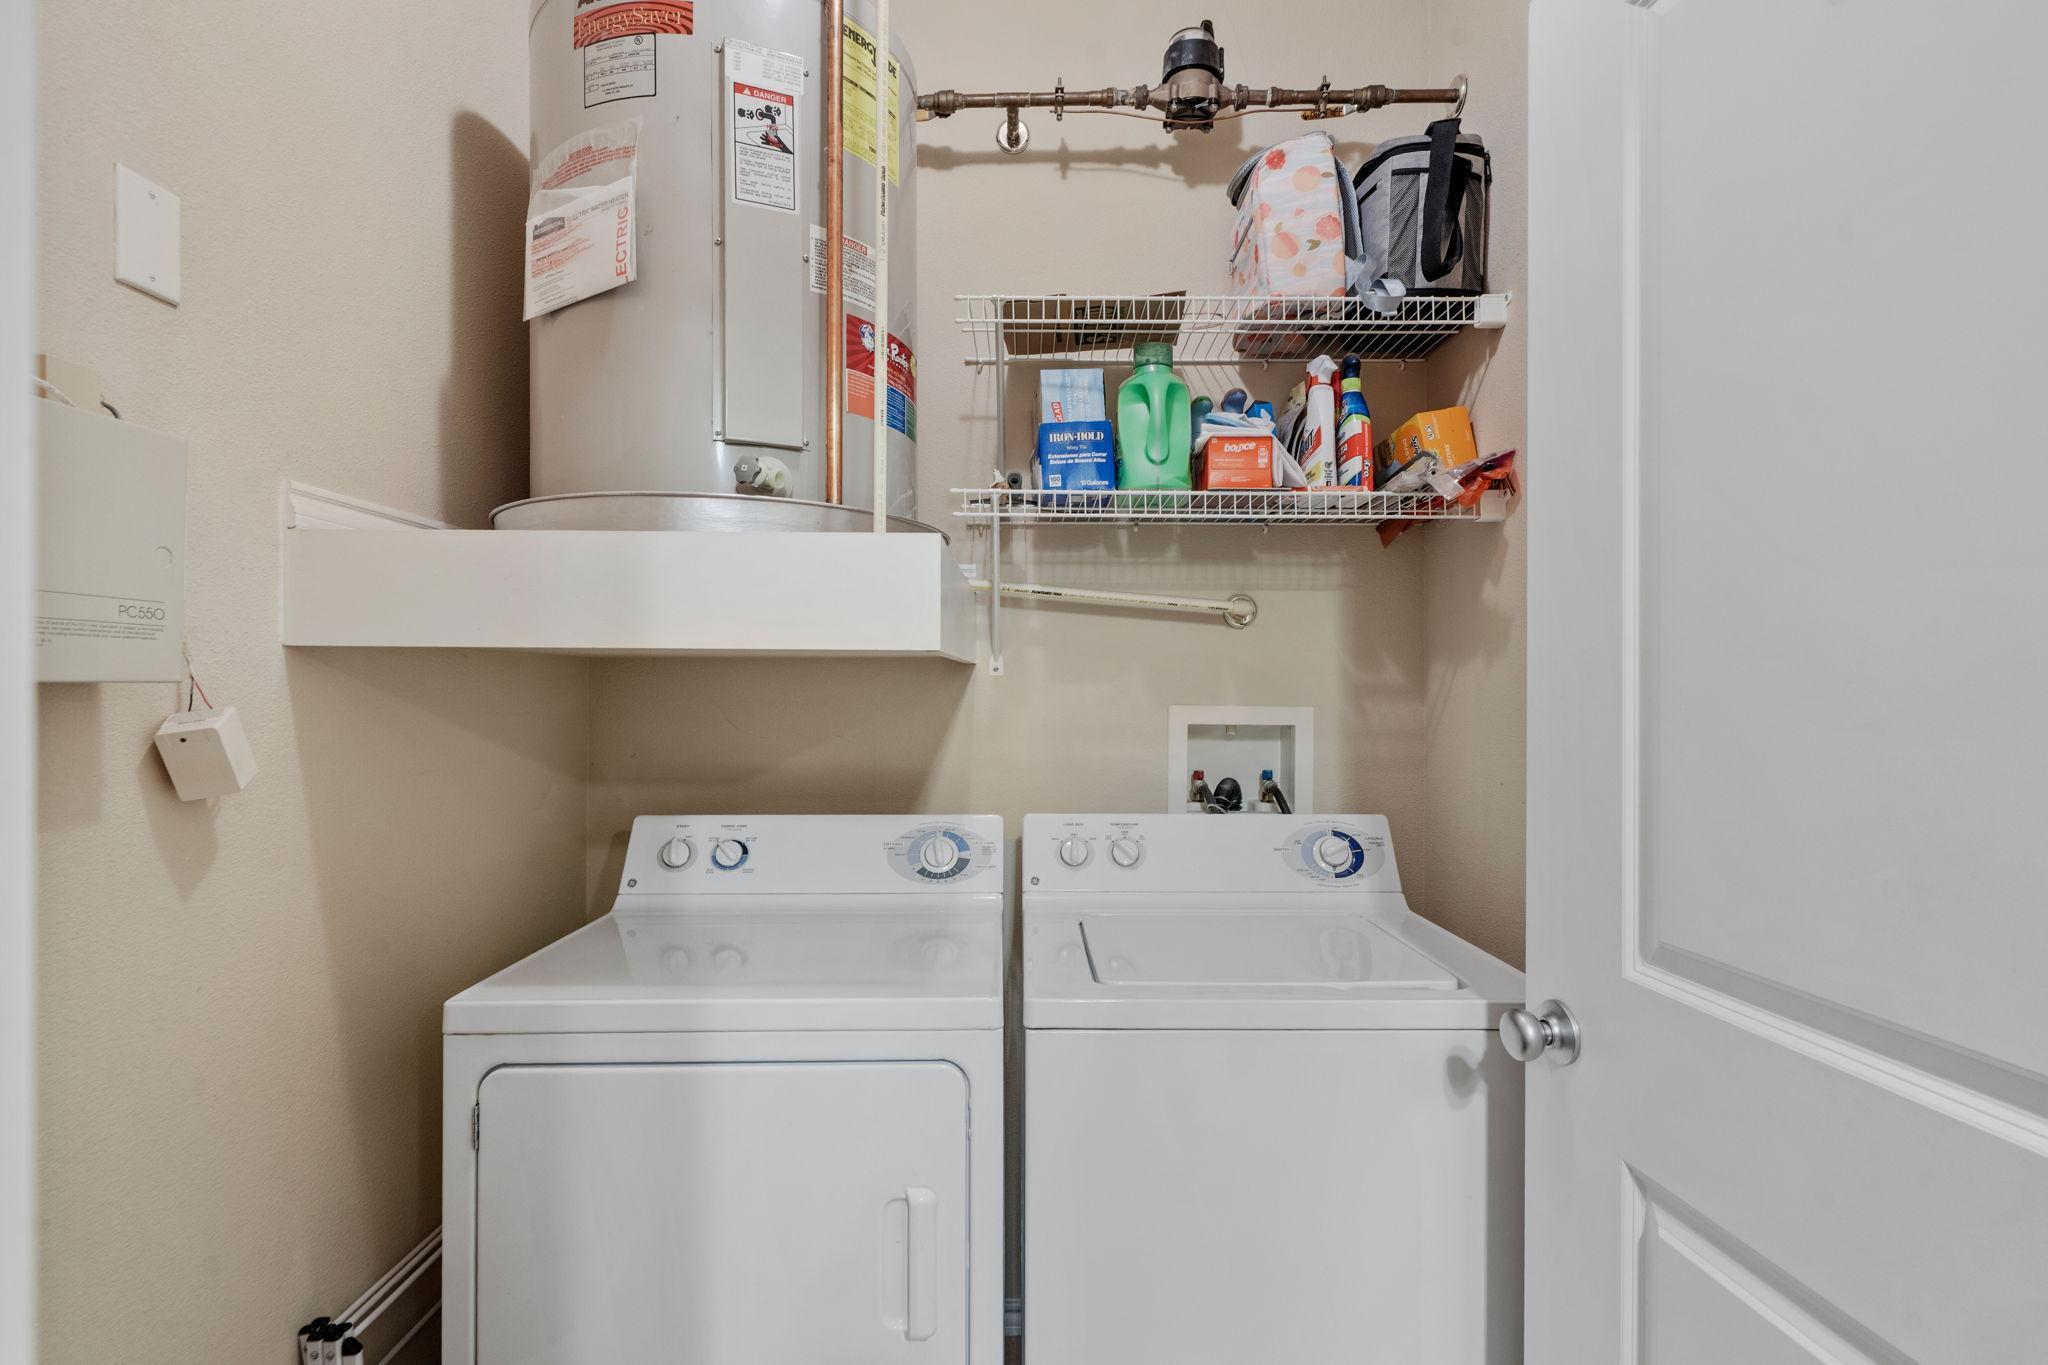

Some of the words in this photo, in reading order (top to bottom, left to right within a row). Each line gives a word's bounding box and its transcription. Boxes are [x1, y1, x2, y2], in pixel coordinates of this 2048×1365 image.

[577, 6, 685, 39] EnergySaver
[753, 90, 787, 104] DANGER
[1049, 431, 1105, 443] IRON-HOLD
[1224, 441, 1256, 453] bounce
[118, 604, 165, 621] PC550
